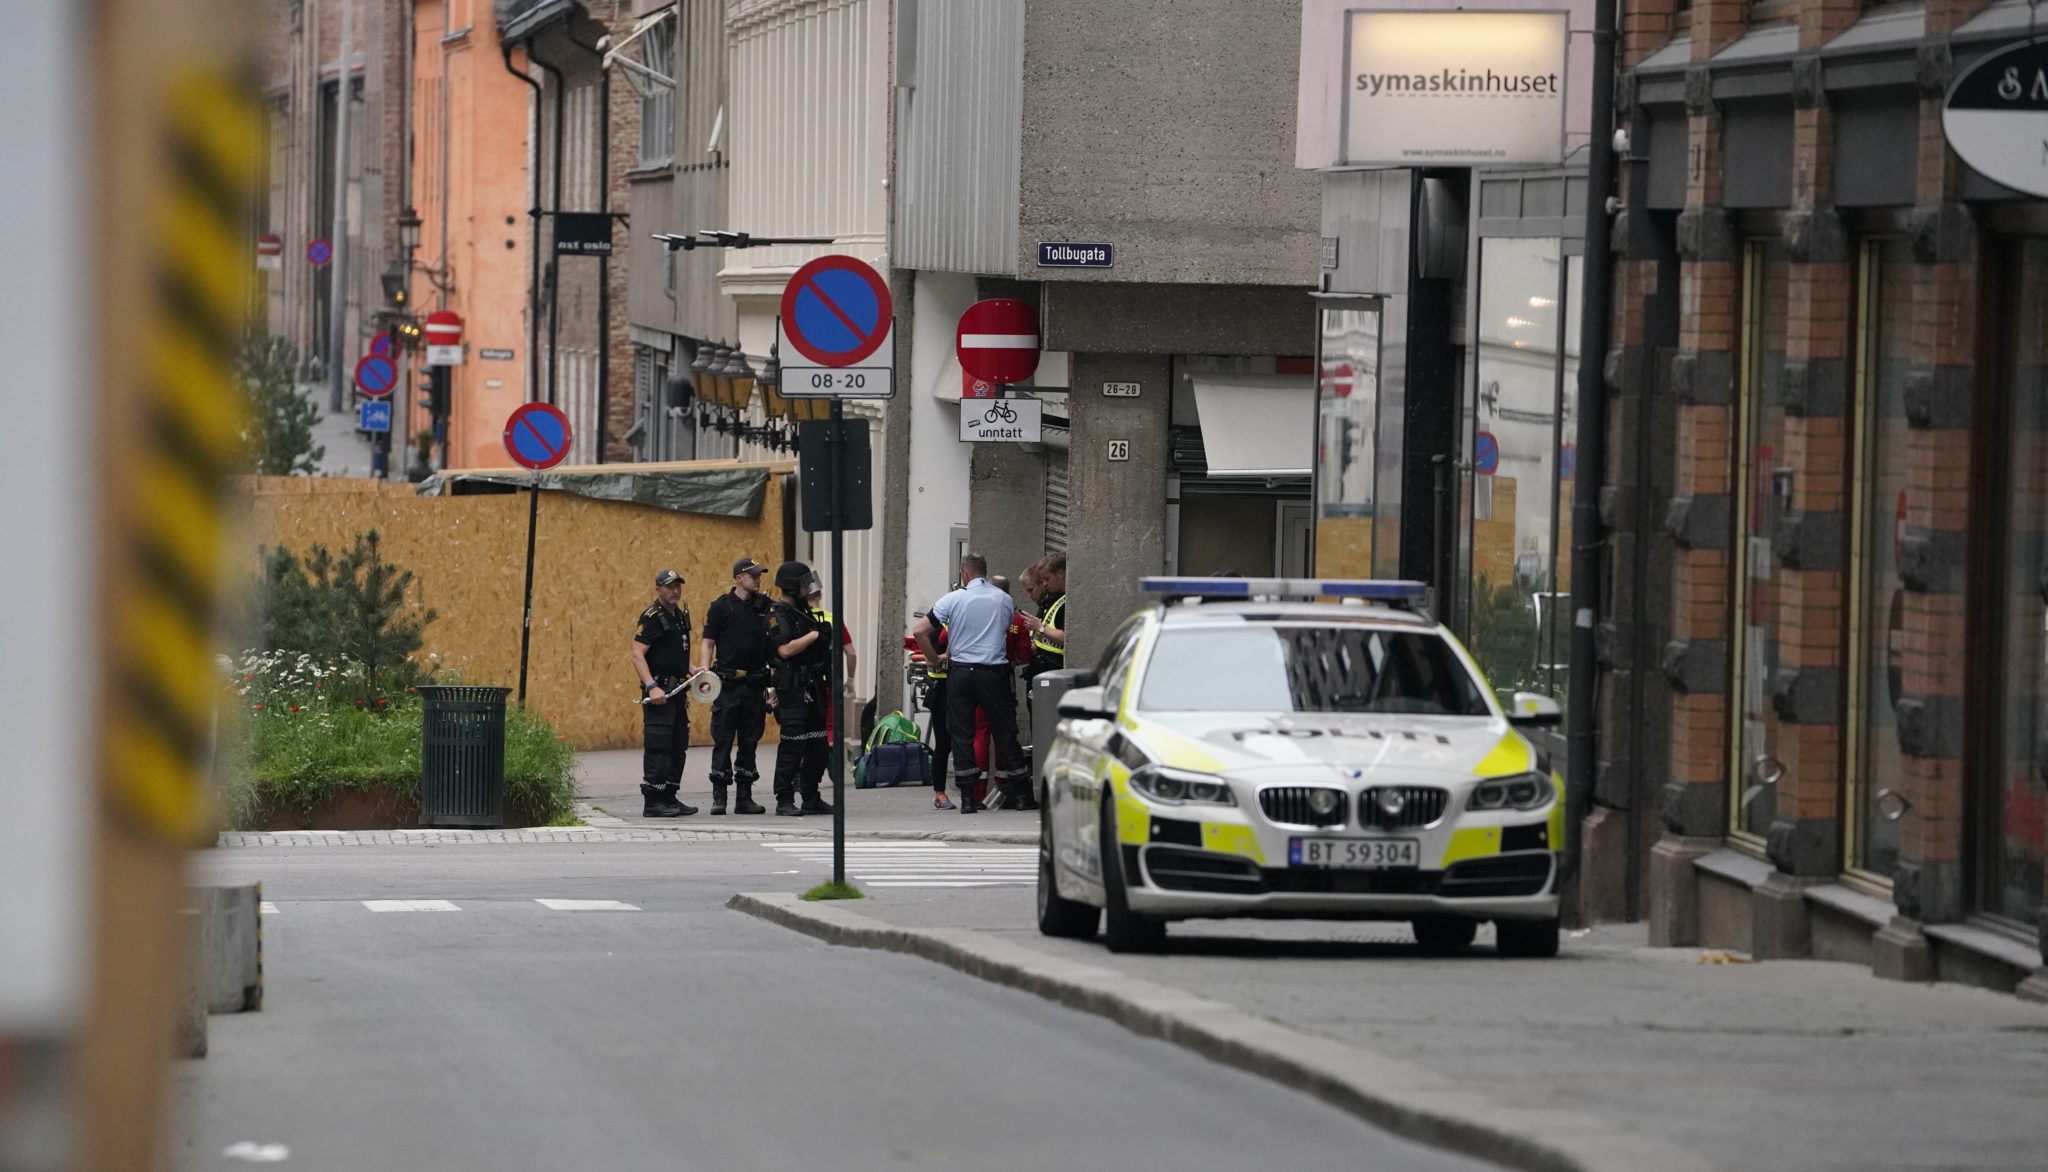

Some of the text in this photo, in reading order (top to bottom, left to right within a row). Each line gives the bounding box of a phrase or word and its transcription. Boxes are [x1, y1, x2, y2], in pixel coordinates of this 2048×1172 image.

[1356, 68, 1558, 96] symaskinhuset
[1045, 246, 1105, 264] Tollbugata
[1106, 384, 1137, 395] 26-28
[978, 427, 1023, 438] unntatt
[1110, 442, 1127, 458] 26
[1308, 843, 1412, 862] BT 59304
